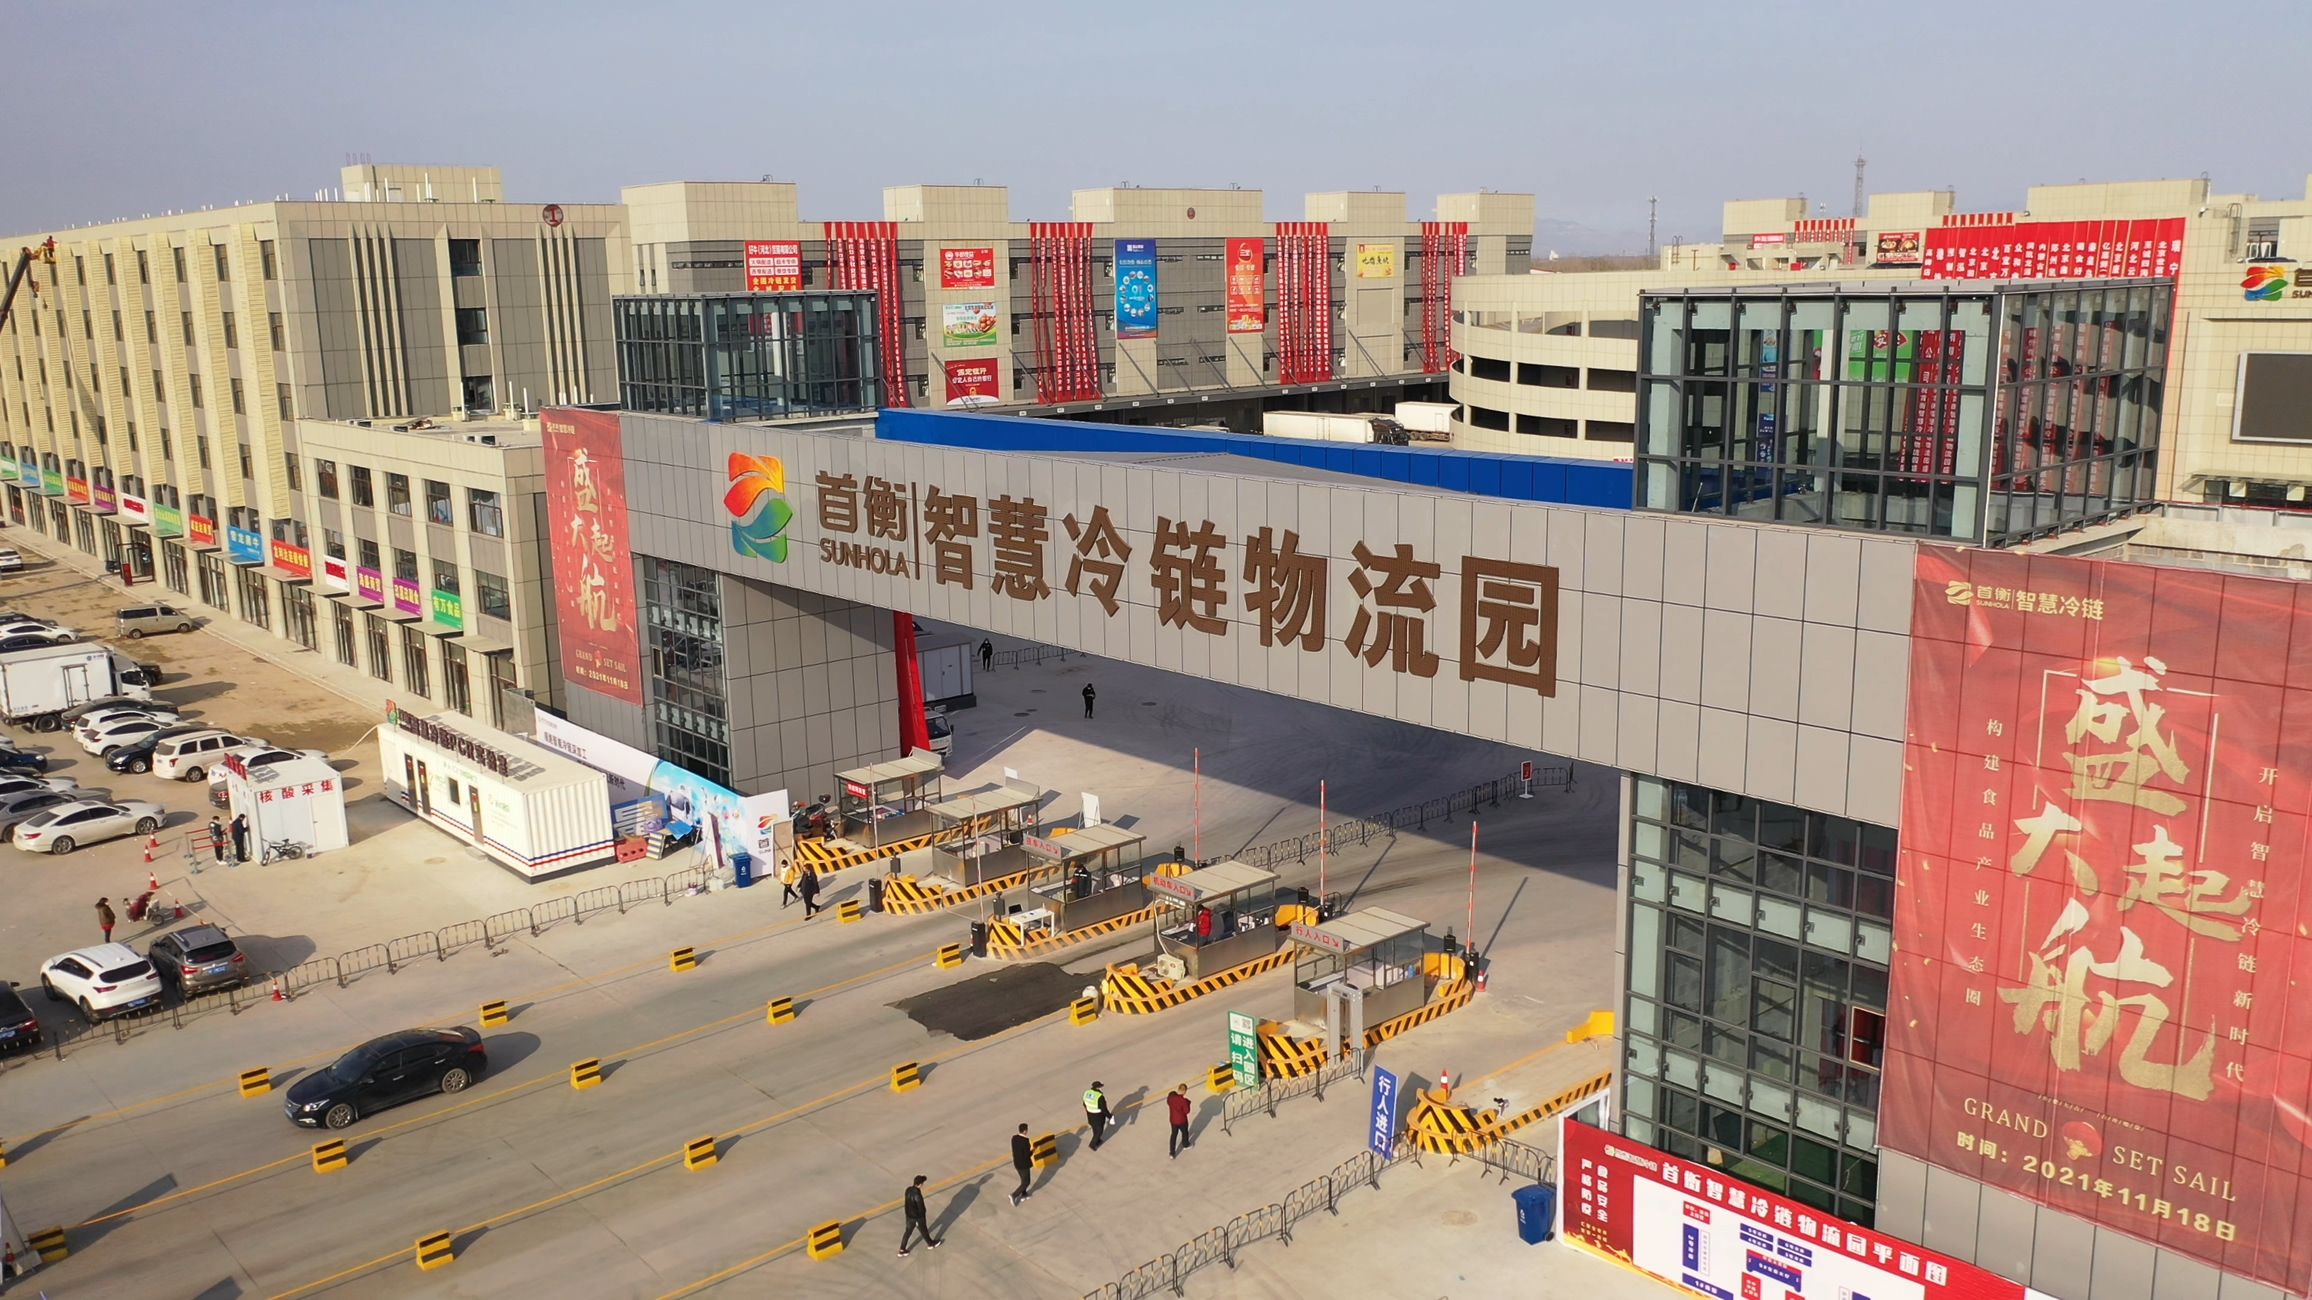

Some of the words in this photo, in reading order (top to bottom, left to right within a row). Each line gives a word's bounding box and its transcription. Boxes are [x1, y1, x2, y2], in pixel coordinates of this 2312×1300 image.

[815, 470, 907, 542] 首衡
[924, 484, 1559, 698] 智慧冷链物流园
[819, 538, 911, 579] SUNHOLA
[1976, 585, 2011, 602] 首衡
[2016, 590, 2104, 620] 智慧冷链
[260, 779, 333, 803] 核酸采集
[1965, 718, 2003, 1006] 构建食品产业生态圈
[1997, 656, 2252, 1101] 盛大起航
[2226, 766, 2279, 1082] 开启智慧冷链新时代
[1964, 1097, 2048, 1138] GRAND
[2112, 1145, 2164, 1177] SET
[2173, 1165, 2237, 1202] SAIL
[2023, 1155, 2237, 1242] 2021年11月18日
[1662, 1161, 1948, 1287] 首衡智慧冷链物流园平面图
